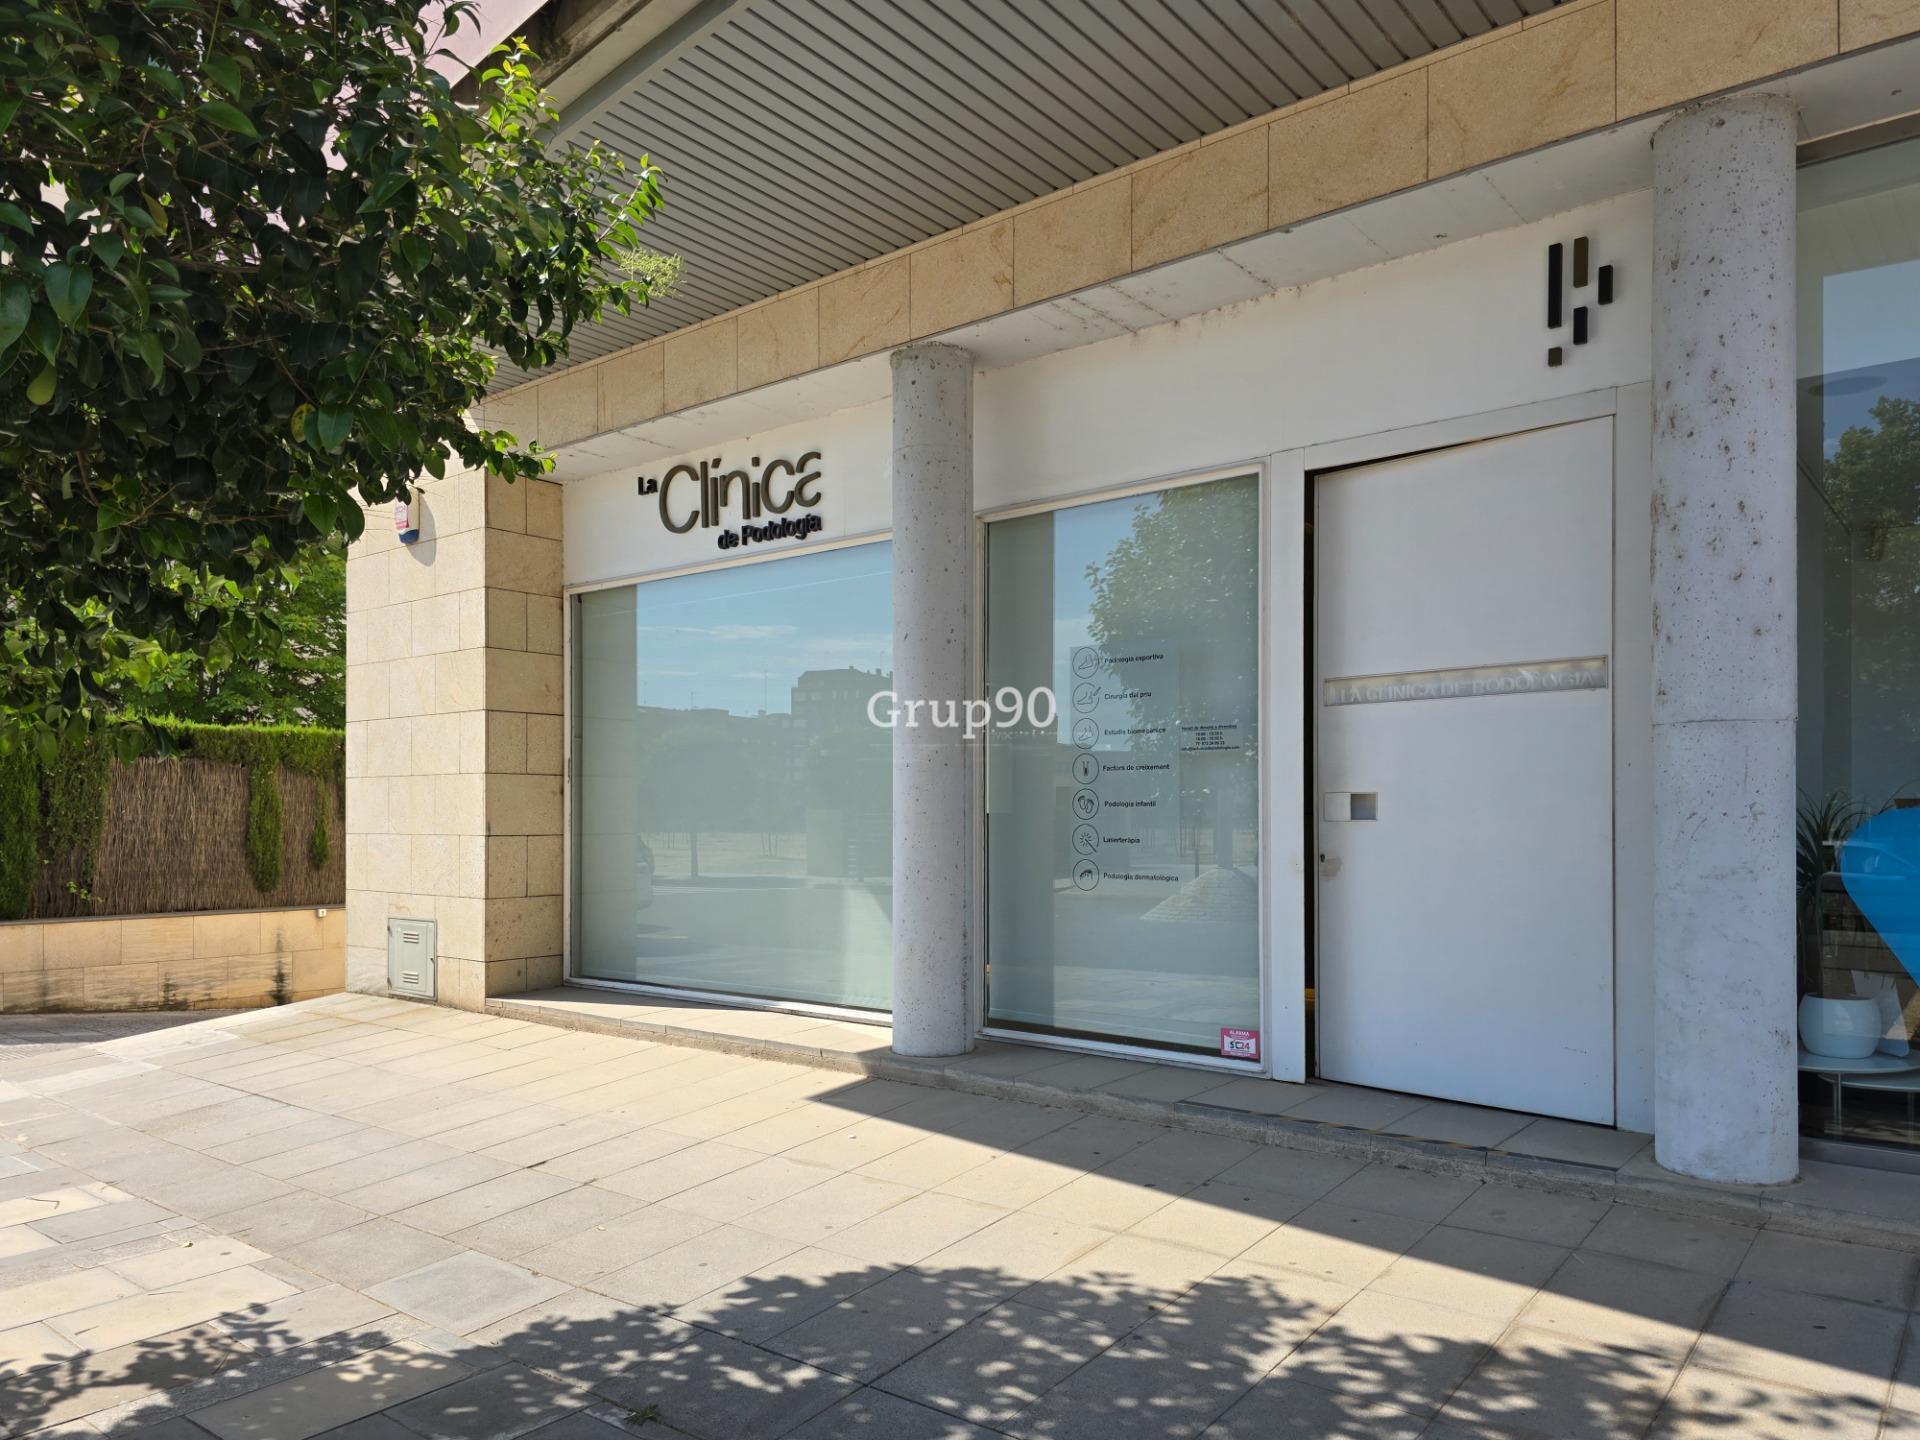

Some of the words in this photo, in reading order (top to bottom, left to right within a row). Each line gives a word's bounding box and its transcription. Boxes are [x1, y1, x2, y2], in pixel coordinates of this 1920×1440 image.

[637, 476, 658, 496] La
[659, 451, 822, 534] Clínica
[717, 529, 739, 550] de
[1102, 764, 1125, 772] Factors
